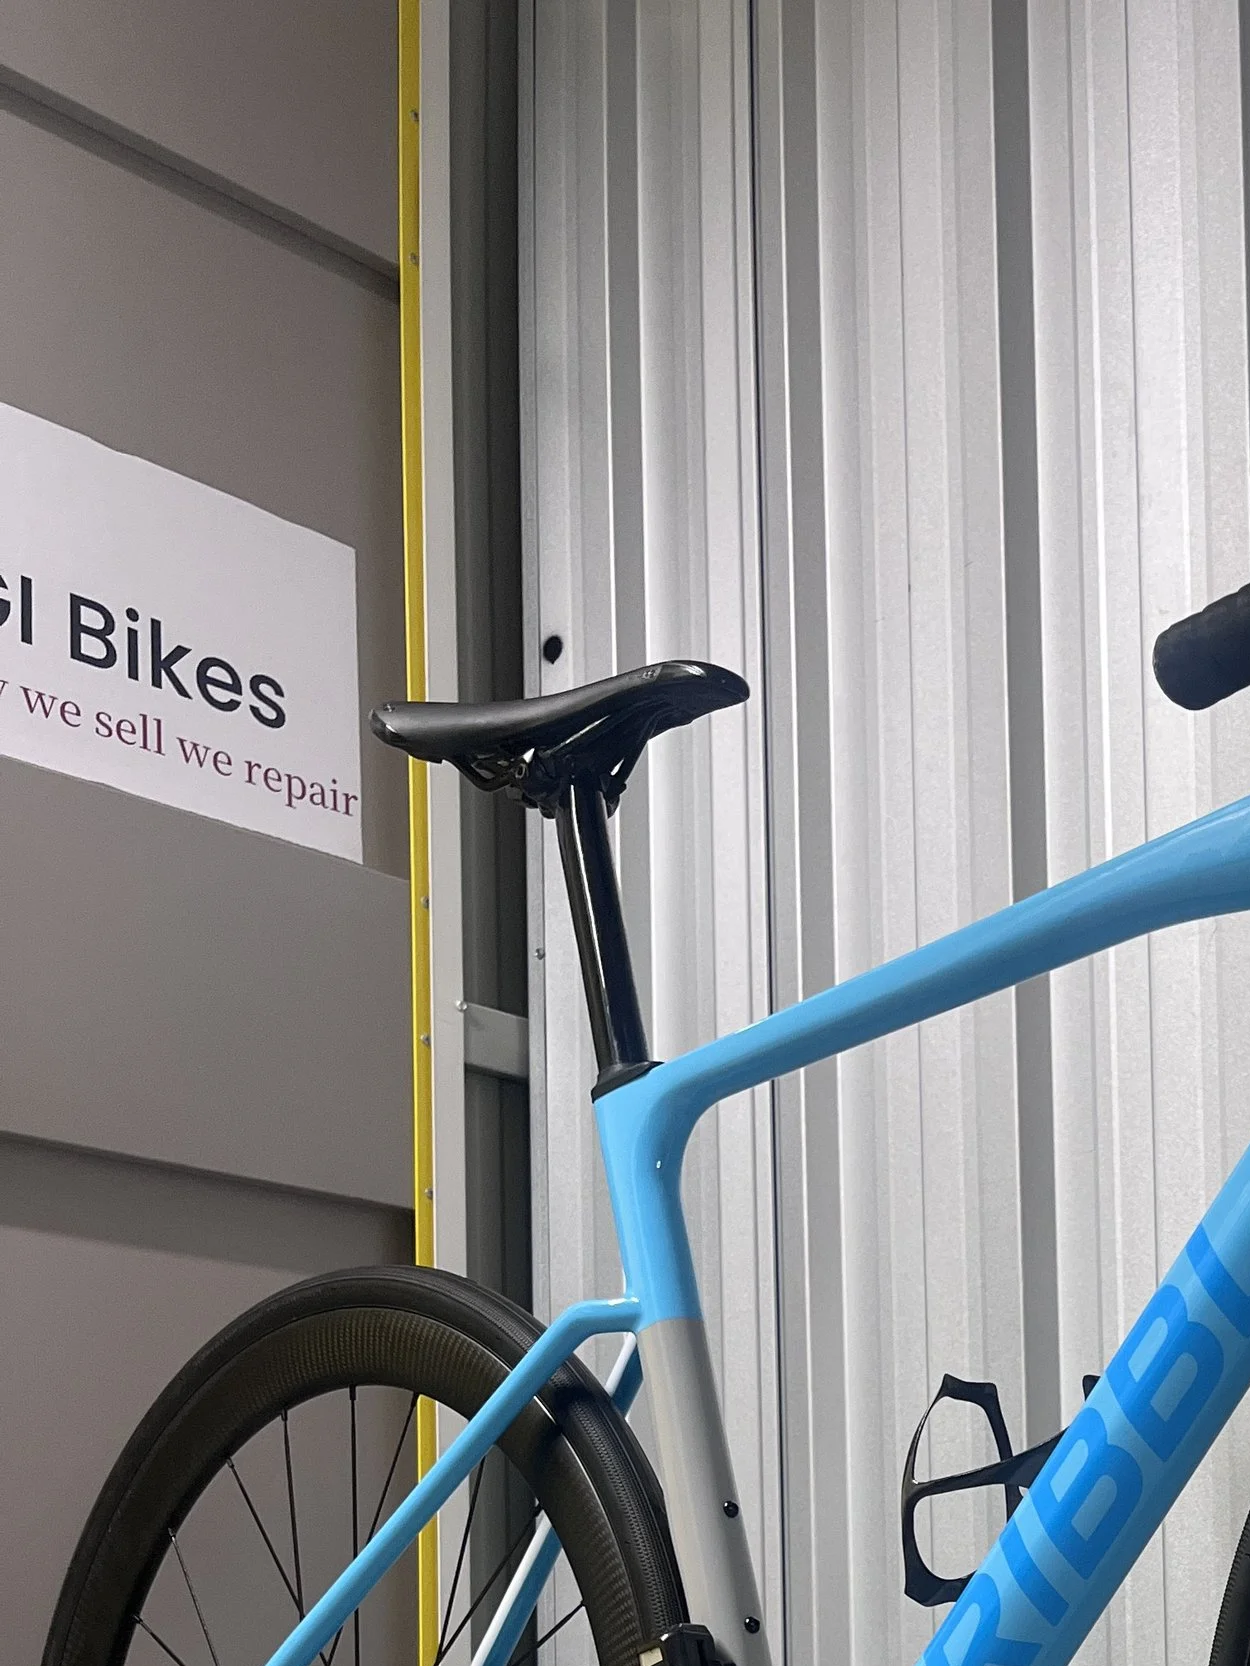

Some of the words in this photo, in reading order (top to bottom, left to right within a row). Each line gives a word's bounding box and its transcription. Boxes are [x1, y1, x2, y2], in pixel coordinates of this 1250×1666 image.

[0, 573, 33, 646] I
[69, 592, 286, 729] Bikes
[20, 686, 82, 729] we
[95, 713, 166, 756] sell
[176, 736, 234, 777] we
[244, 757, 359, 817] repair
